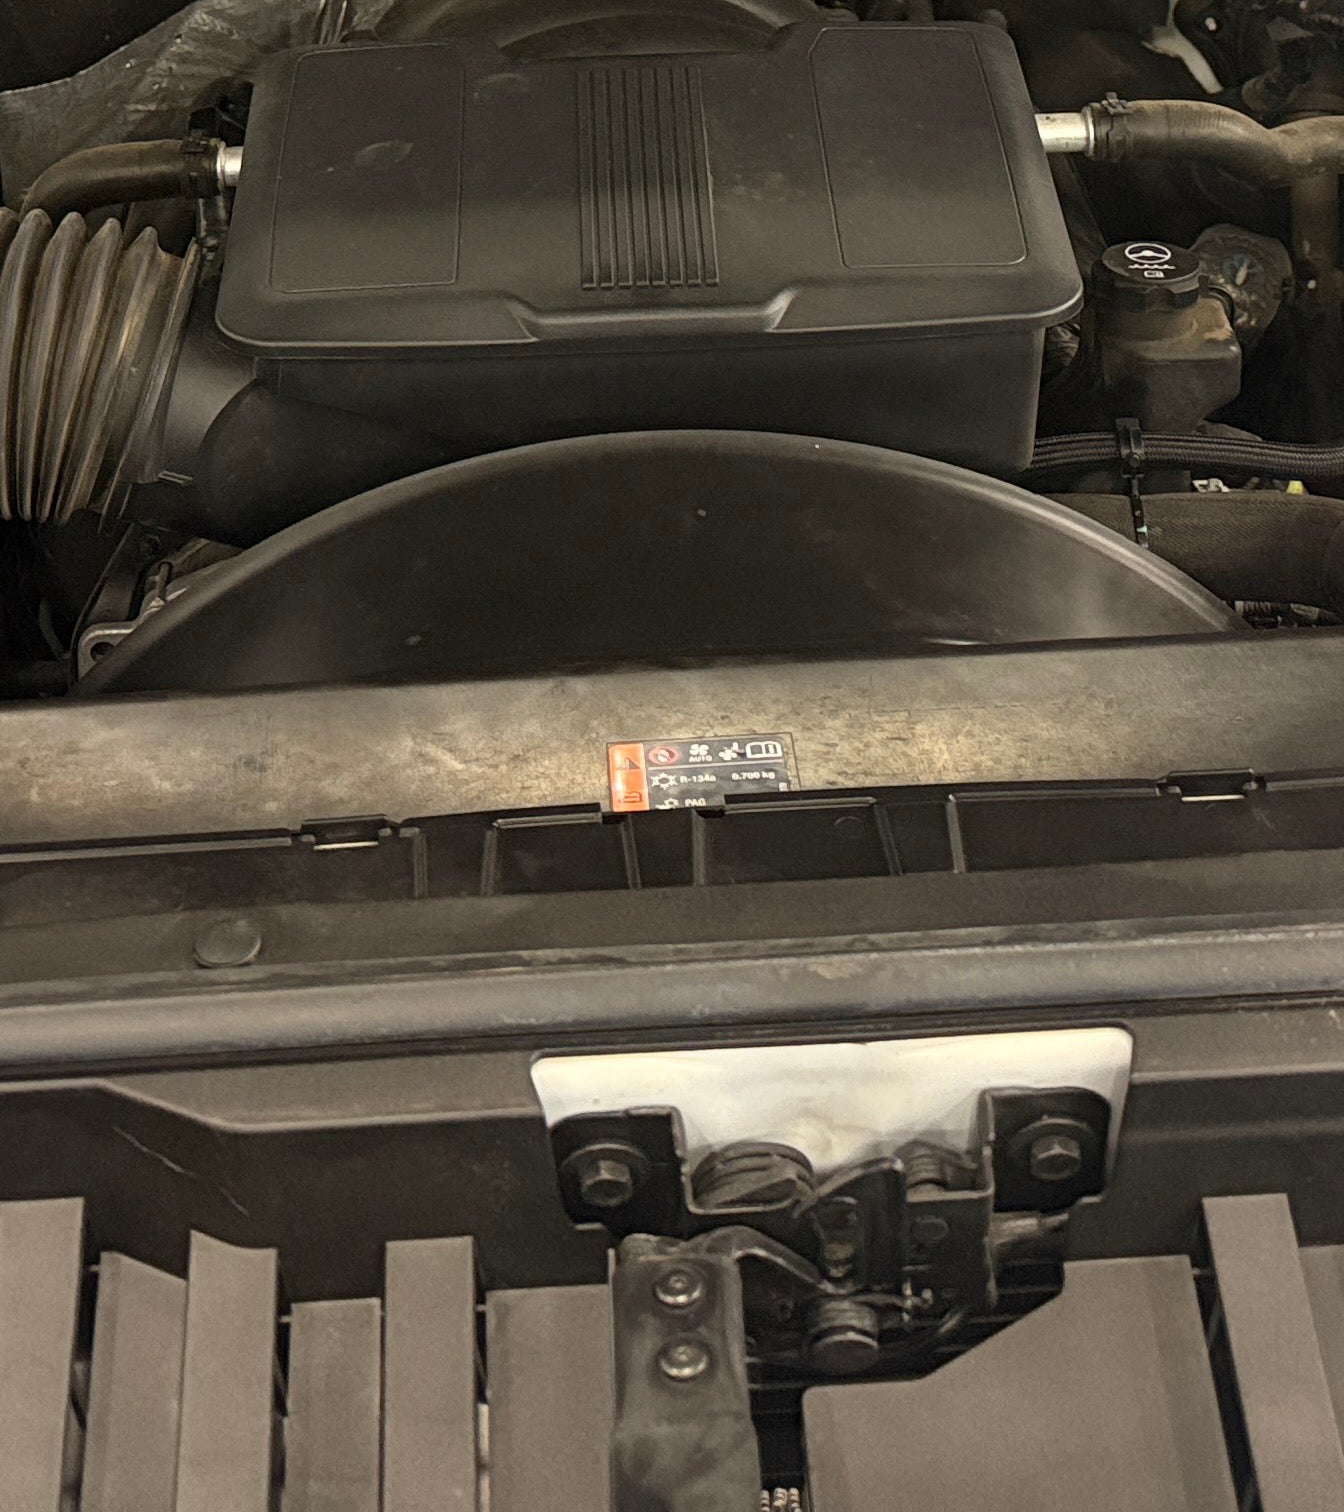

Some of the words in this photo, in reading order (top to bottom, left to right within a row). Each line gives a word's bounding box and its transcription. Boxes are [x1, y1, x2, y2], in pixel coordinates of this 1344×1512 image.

[689, 755, 713, 763] AUTO
[679, 774, 717, 784] R-134a
[762, 771, 776, 780] kg
[685, 798, 707, 808] PAG
